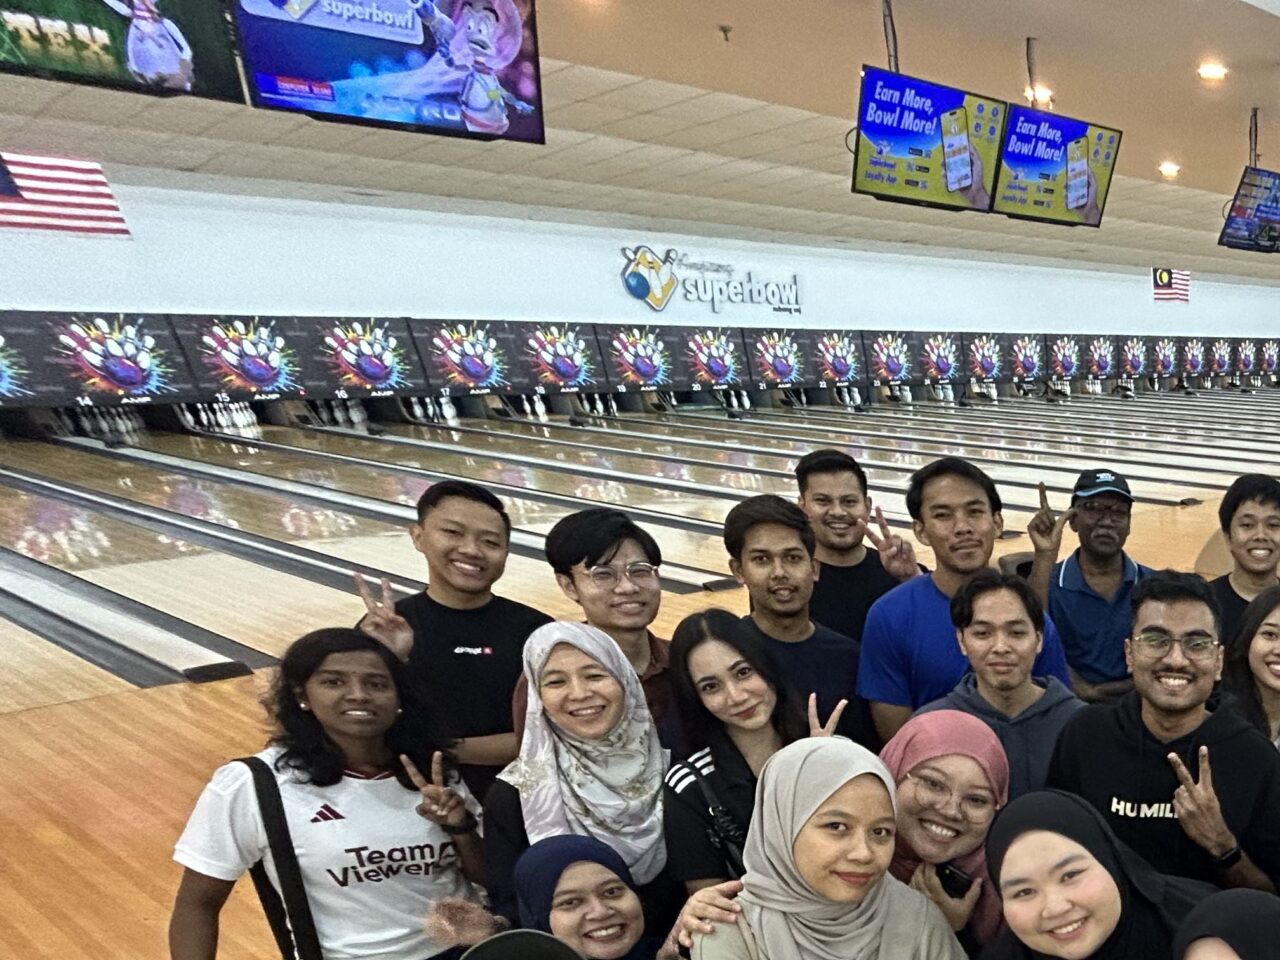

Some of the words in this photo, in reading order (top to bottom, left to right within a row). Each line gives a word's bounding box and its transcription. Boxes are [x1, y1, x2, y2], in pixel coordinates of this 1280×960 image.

[874, 81, 900, 104] Earn
[902, 88, 934, 116] More,
[866, 102, 900, 127] Bowl
[900, 110, 938, 135] More!
[1016, 117, 1037, 134] Earn
[1037, 122, 1062, 143] More,
[1007, 135, 1034, 156] Bowl
[1034, 141, 1065, 161] More!
[681, 272, 800, 313] superbowl
[75, 396, 93, 406] 14
[214, 392, 231, 402] 15
[335, 389, 348, 399] 16
[1110, 796, 1178, 819] HUMIL
[344, 843, 435, 868] Team
[326, 861, 435, 887] Viewer
